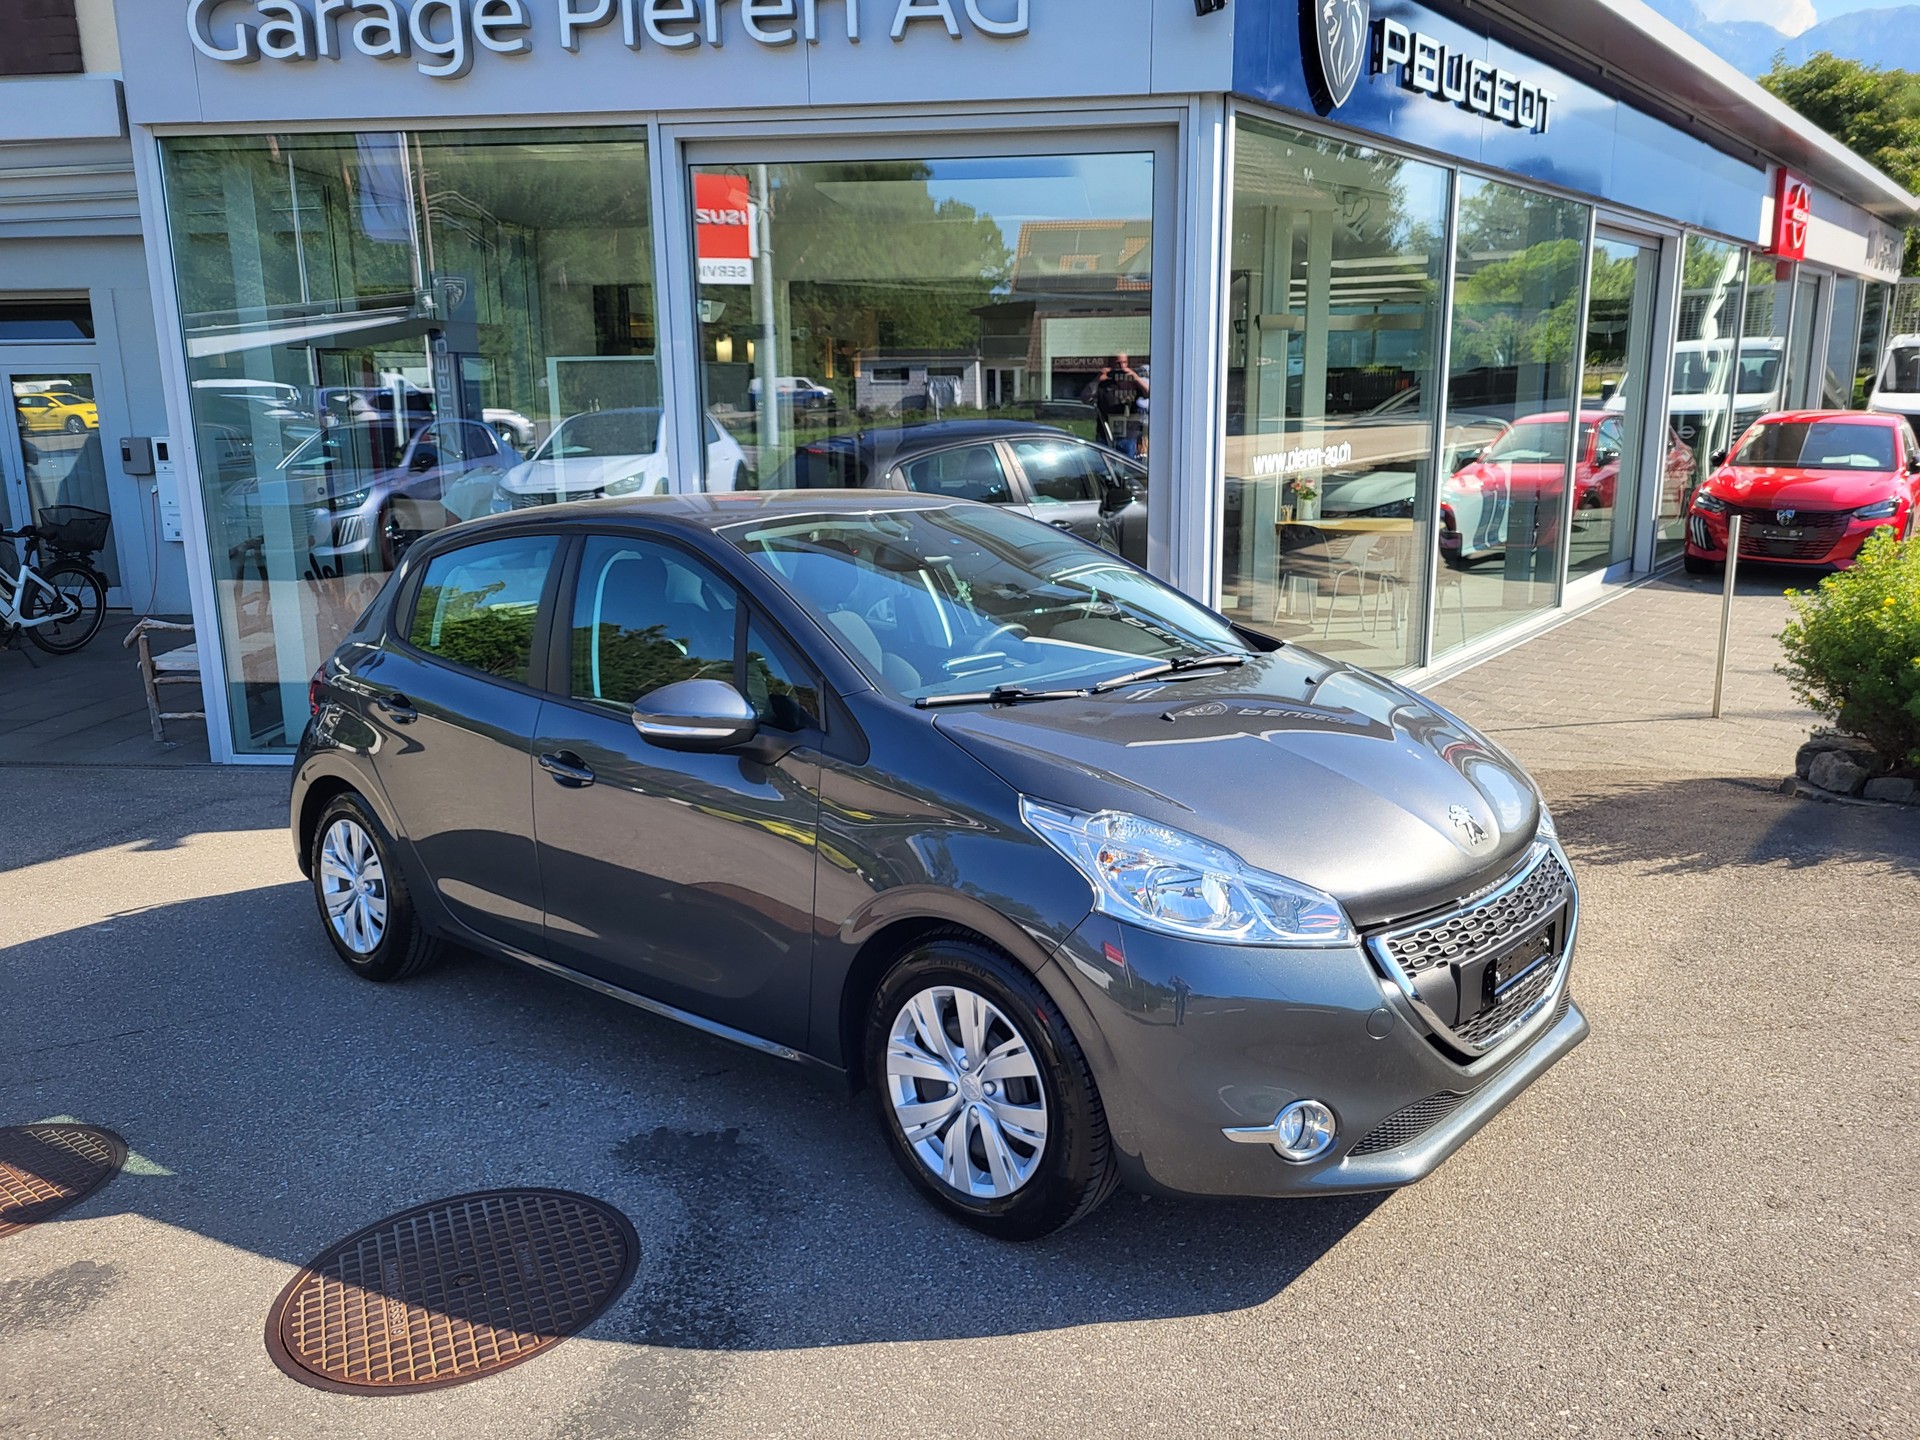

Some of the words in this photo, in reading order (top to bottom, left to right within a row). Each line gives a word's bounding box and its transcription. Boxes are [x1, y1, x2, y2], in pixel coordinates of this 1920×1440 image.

[186, 0, 533, 80] Garage
[558, 0, 862, 53] Pieren
[888, 0, 1029, 42] AG
[1379, 17, 1558, 135] PEUGEOT
[1252, 440, 1352, 476] www.pieren-ag.ch
